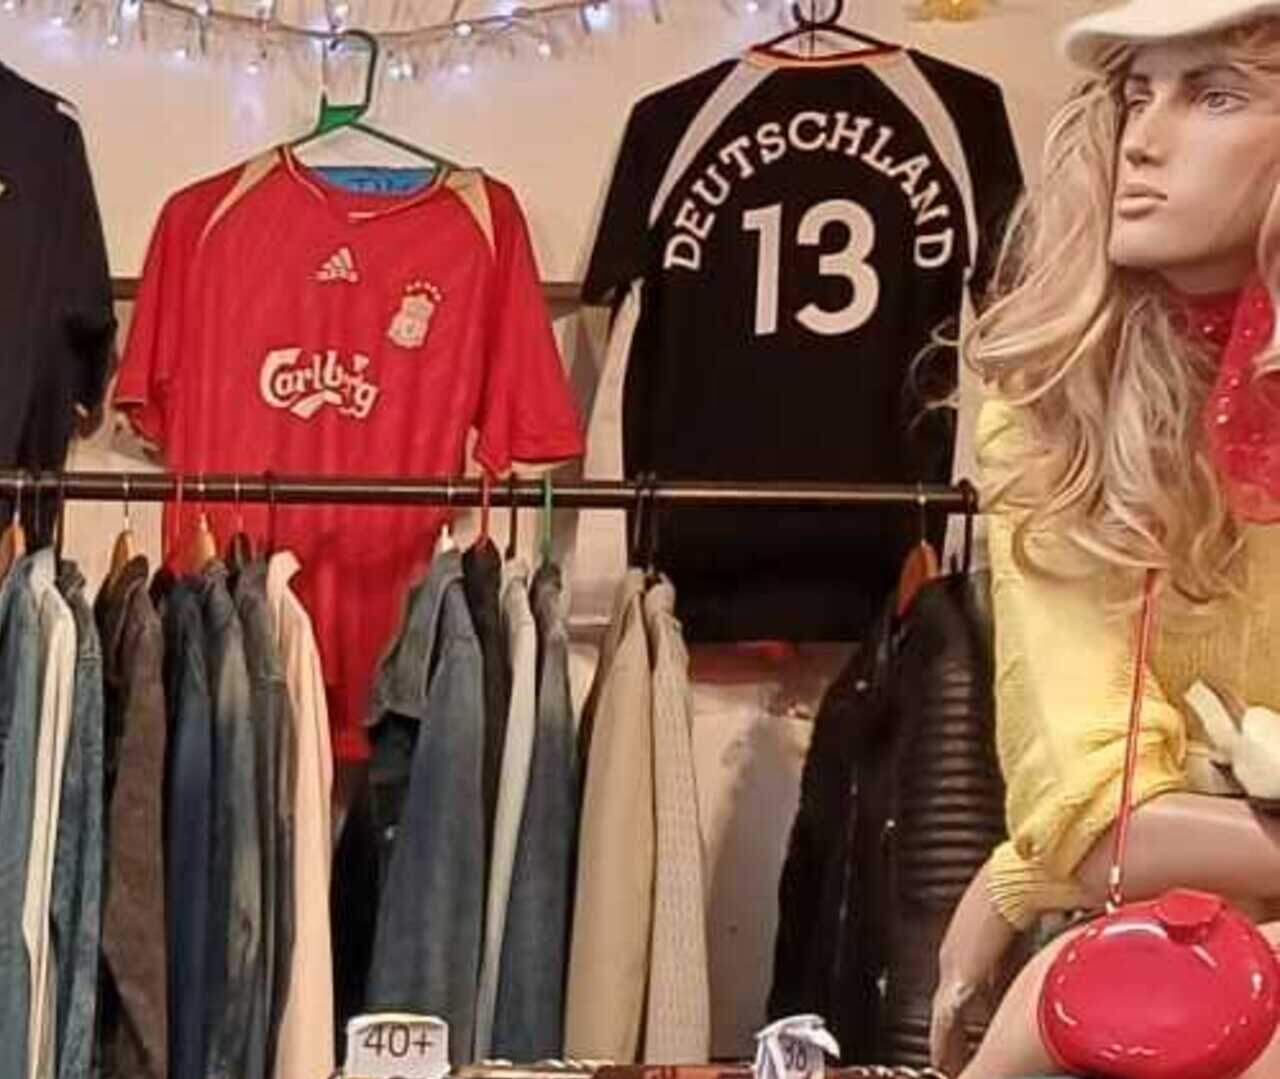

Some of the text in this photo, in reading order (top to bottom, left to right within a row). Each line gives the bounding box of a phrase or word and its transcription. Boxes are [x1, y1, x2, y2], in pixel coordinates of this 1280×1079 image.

[663, 111, 953, 271] DEUTSCHLAND
[742, 198, 880, 337] 13
[363, 1023, 434, 1058] 40+
